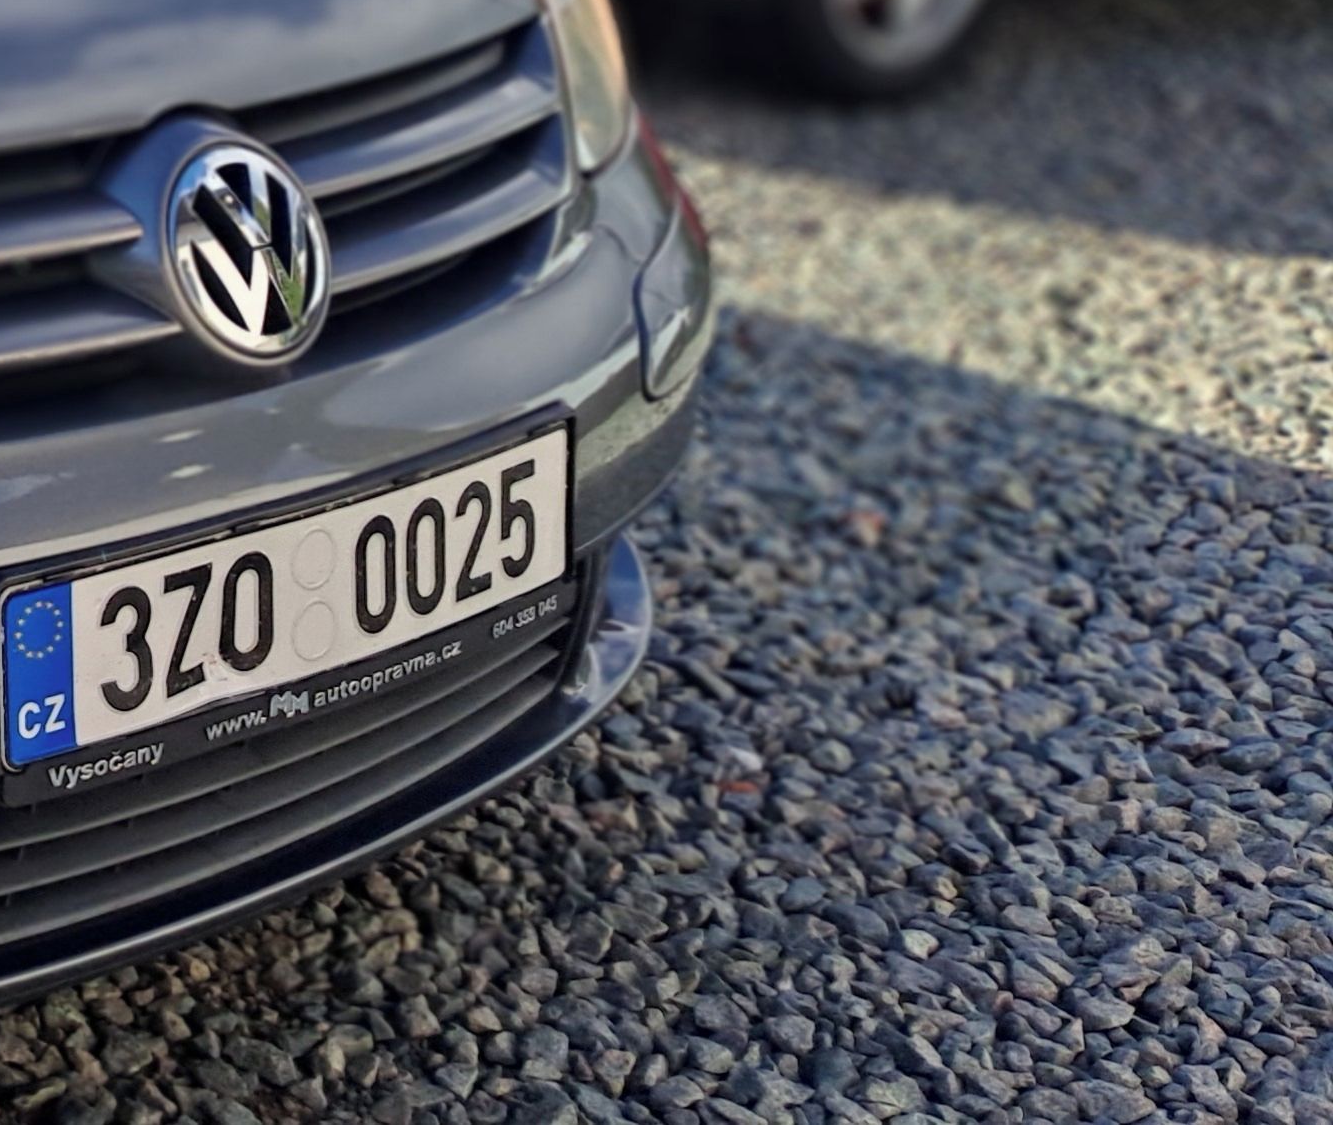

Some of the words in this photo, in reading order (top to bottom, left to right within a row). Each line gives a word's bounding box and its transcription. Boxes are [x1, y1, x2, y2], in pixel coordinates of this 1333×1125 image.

[167, 143, 329, 359] VW
[99, 552, 273, 712] 3Z0
[353, 458, 536, 634] 0025
[17, 693, 66, 739] CZ
[48, 742, 164, 789] Vysočany
